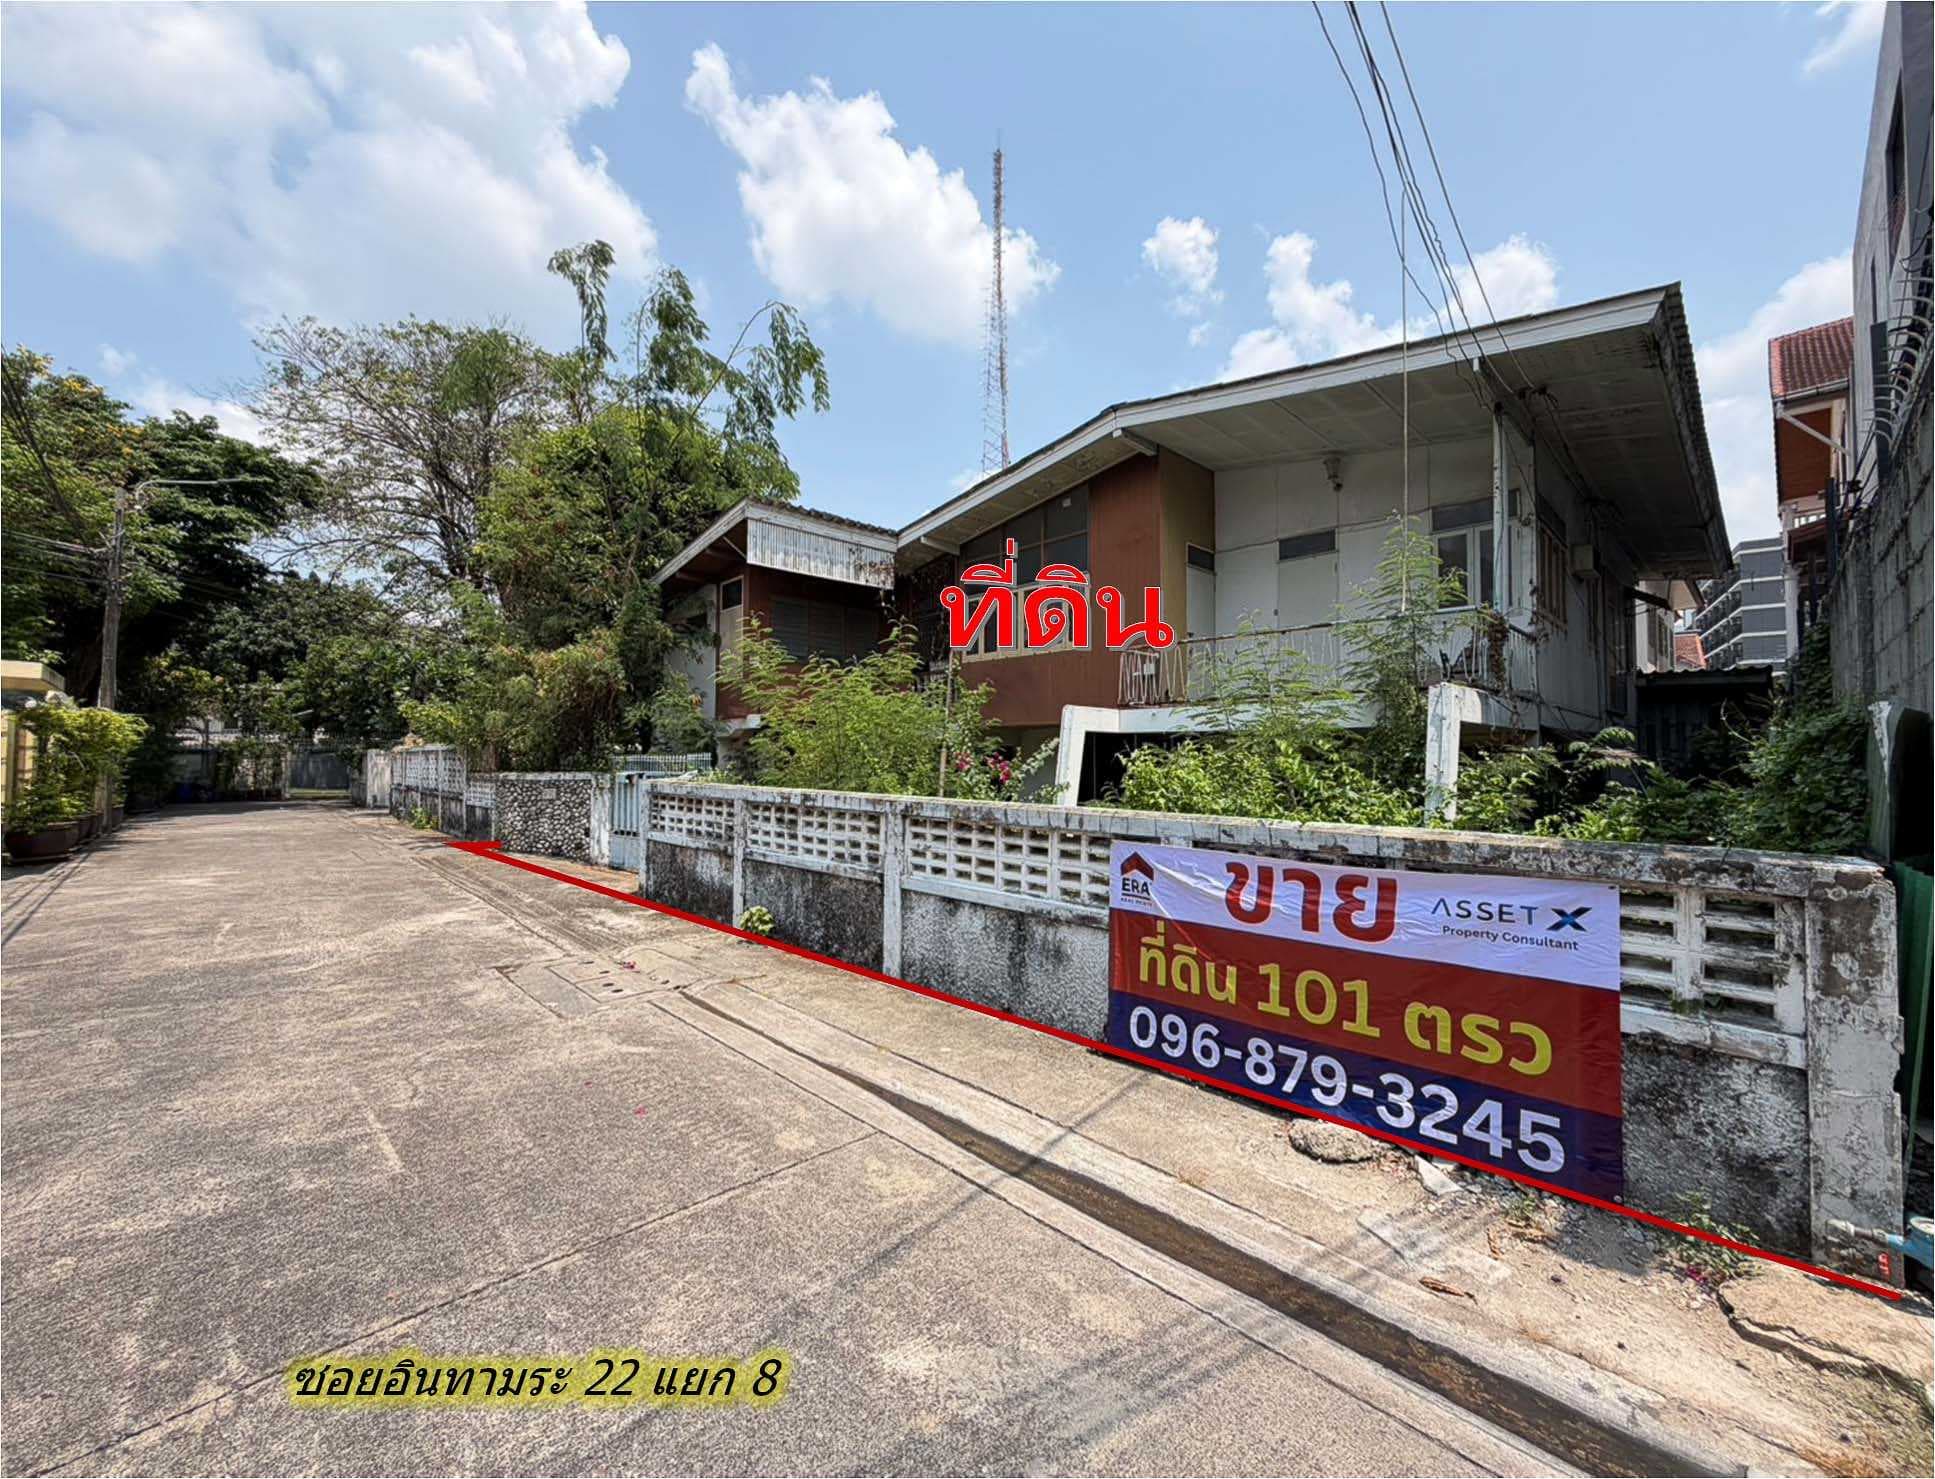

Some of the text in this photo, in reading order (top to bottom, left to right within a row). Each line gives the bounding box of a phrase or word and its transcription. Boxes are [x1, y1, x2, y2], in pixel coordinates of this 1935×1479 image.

[1121, 877, 1150, 896] ERA
[1225, 861, 1399, 944] ขาย
[1431, 898, 1538, 925] ASSET
[1442, 925, 1579, 950] Property Consultant
[1138, 921, 1553, 1076] ที่ดิน 101 ตรว
[1129, 1005, 1566, 1174] 096-879-3245
